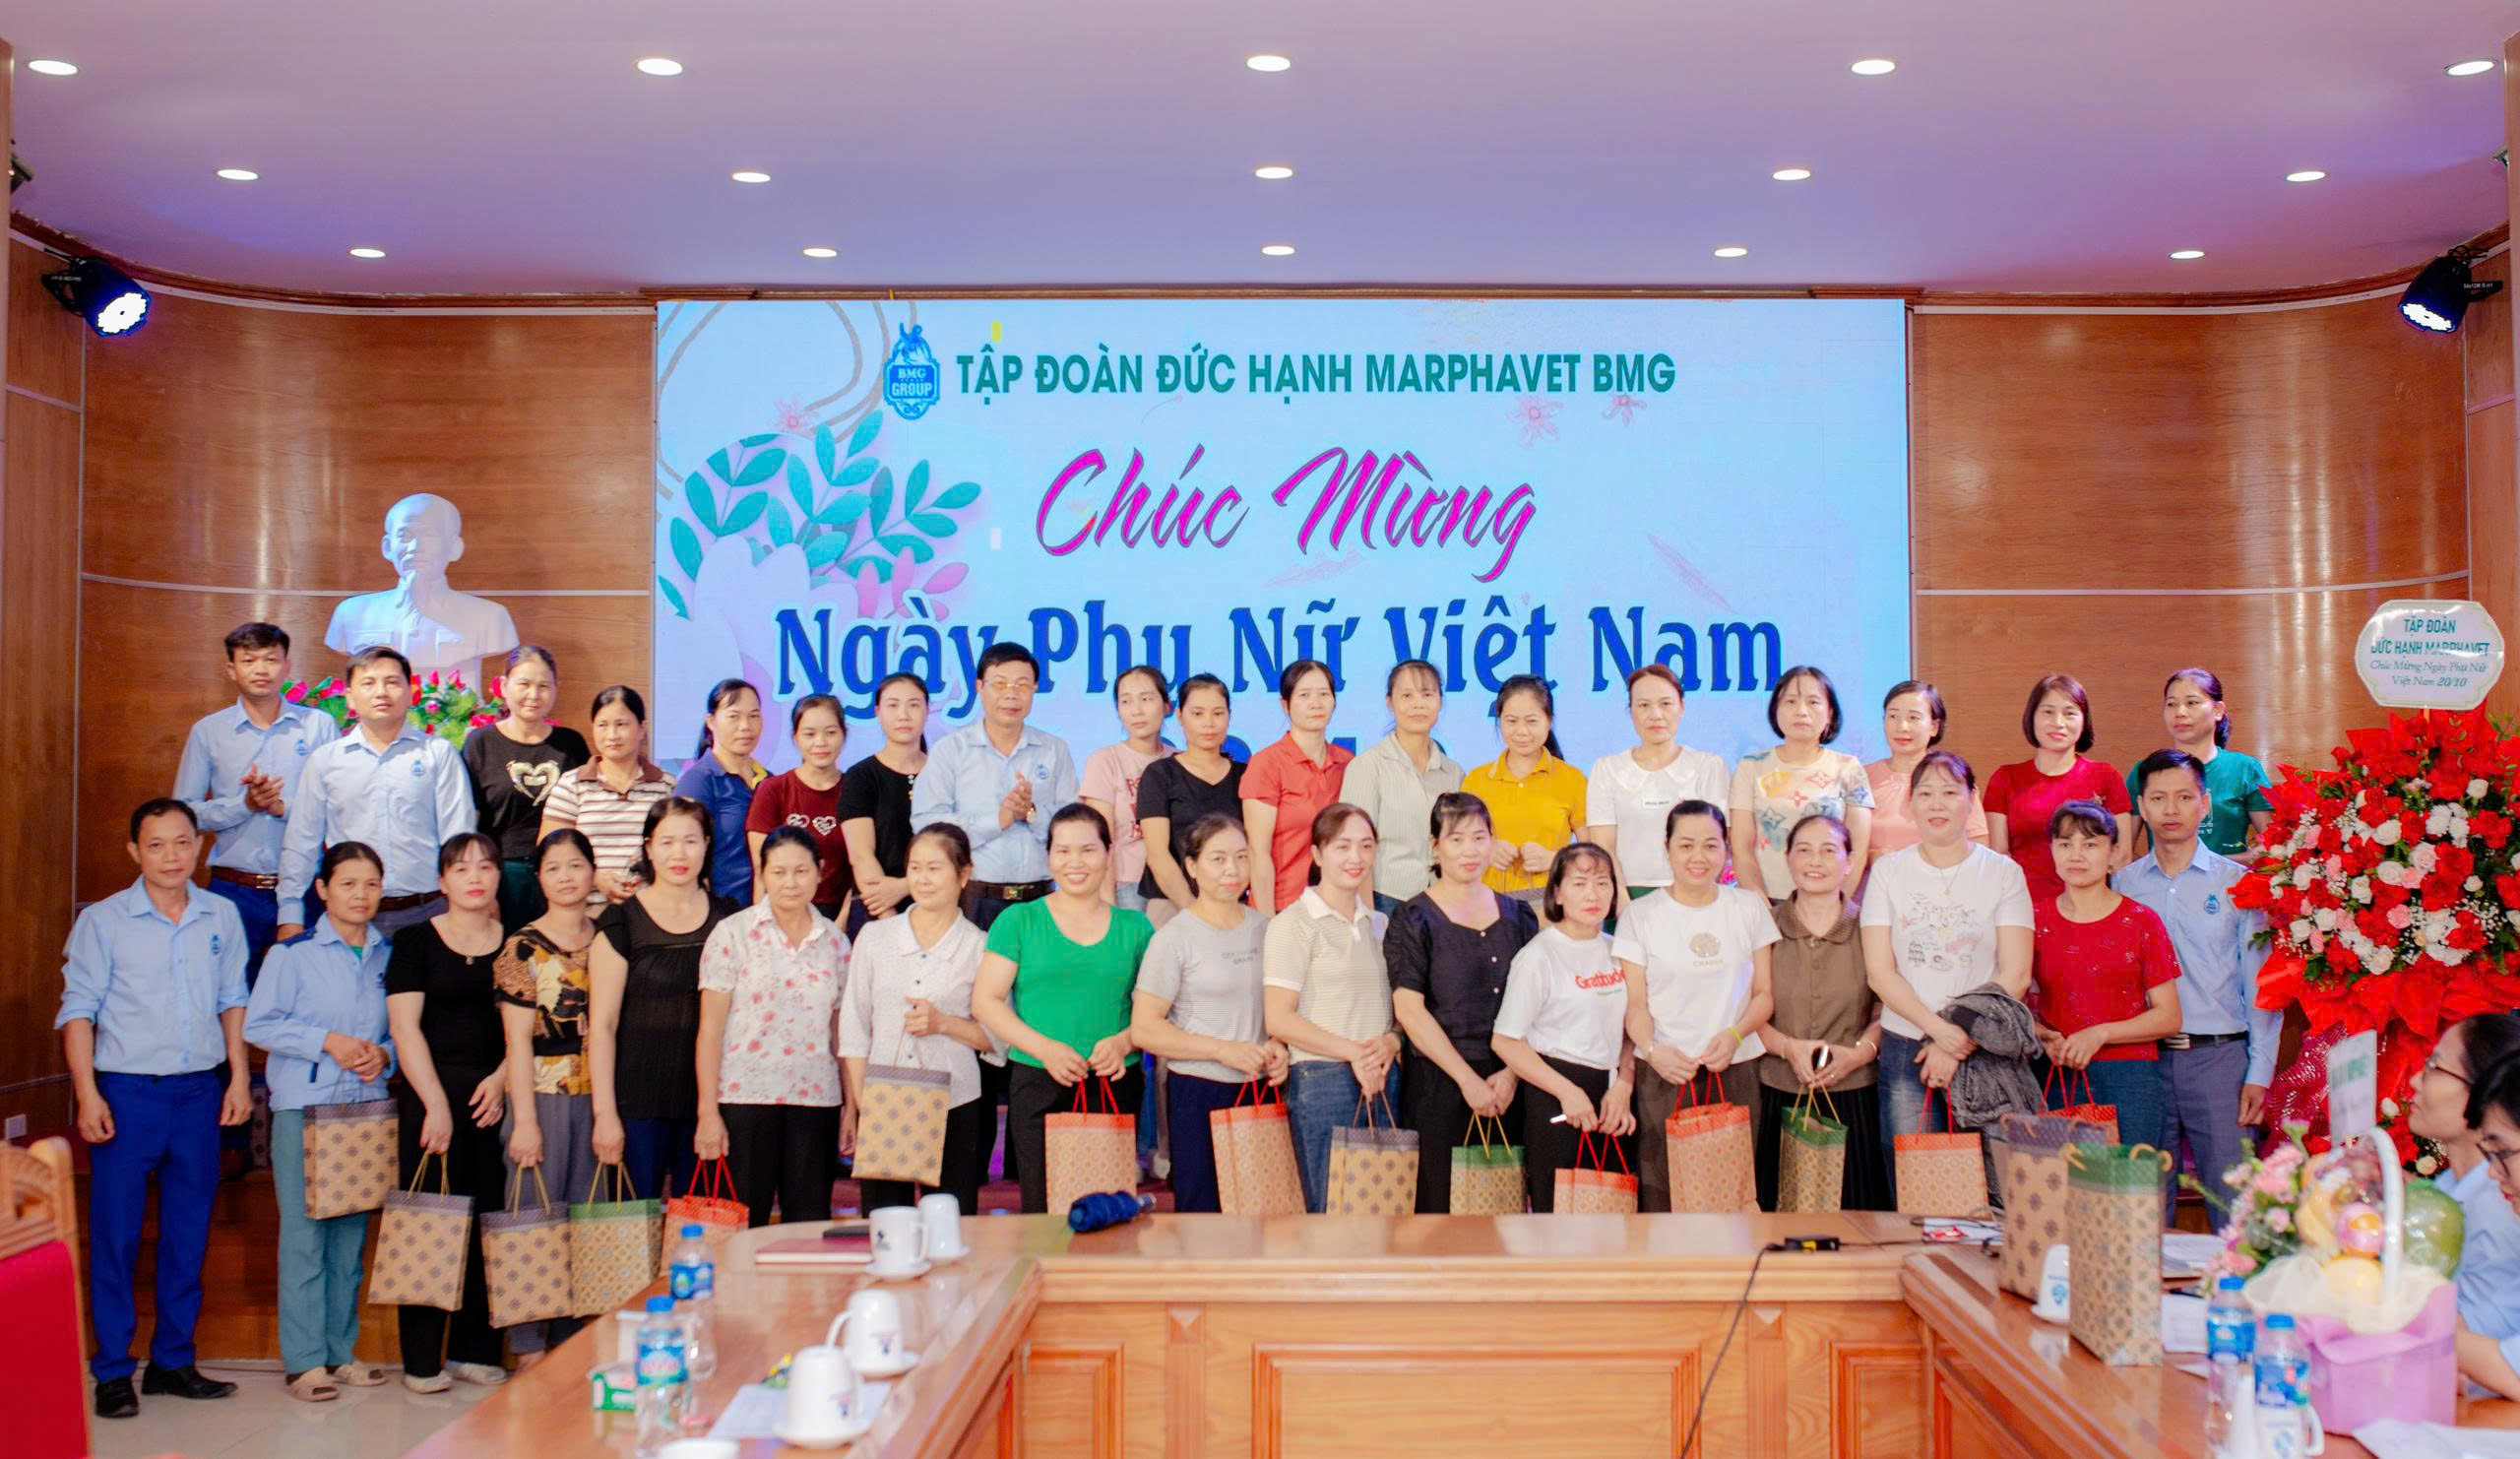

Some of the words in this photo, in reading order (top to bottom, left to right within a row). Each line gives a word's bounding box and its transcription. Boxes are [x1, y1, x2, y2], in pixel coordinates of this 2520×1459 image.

[897, 367, 927, 379] BMG
[957, 344, 1023, 405] TẬP
[1035, 343, 1142, 394] ĐOÀN
[1156, 343, 1235, 394] ĐỨC
[1248, 353, 1352, 404] HẠNH
[1366, 353, 1580, 393] MARPHAVET
[1594, 352, 1675, 394] BMG
[891, 382, 932, 397] GROUP
[1037, 443, 1250, 556] Chúc
[1272, 446, 1537, 583] Mừng
[2404, 615, 2424, 636] TẬP
[2426, 615, 2456, 633] ĐOÀN
[776, 597, 999, 720] Ngày
[1228, 599, 1360, 692] Nữ
[1588, 605, 1783, 692] Nam
[2395, 641, 2423, 658] HẠNH
[2436, 676, 2468, 687] 20/10
